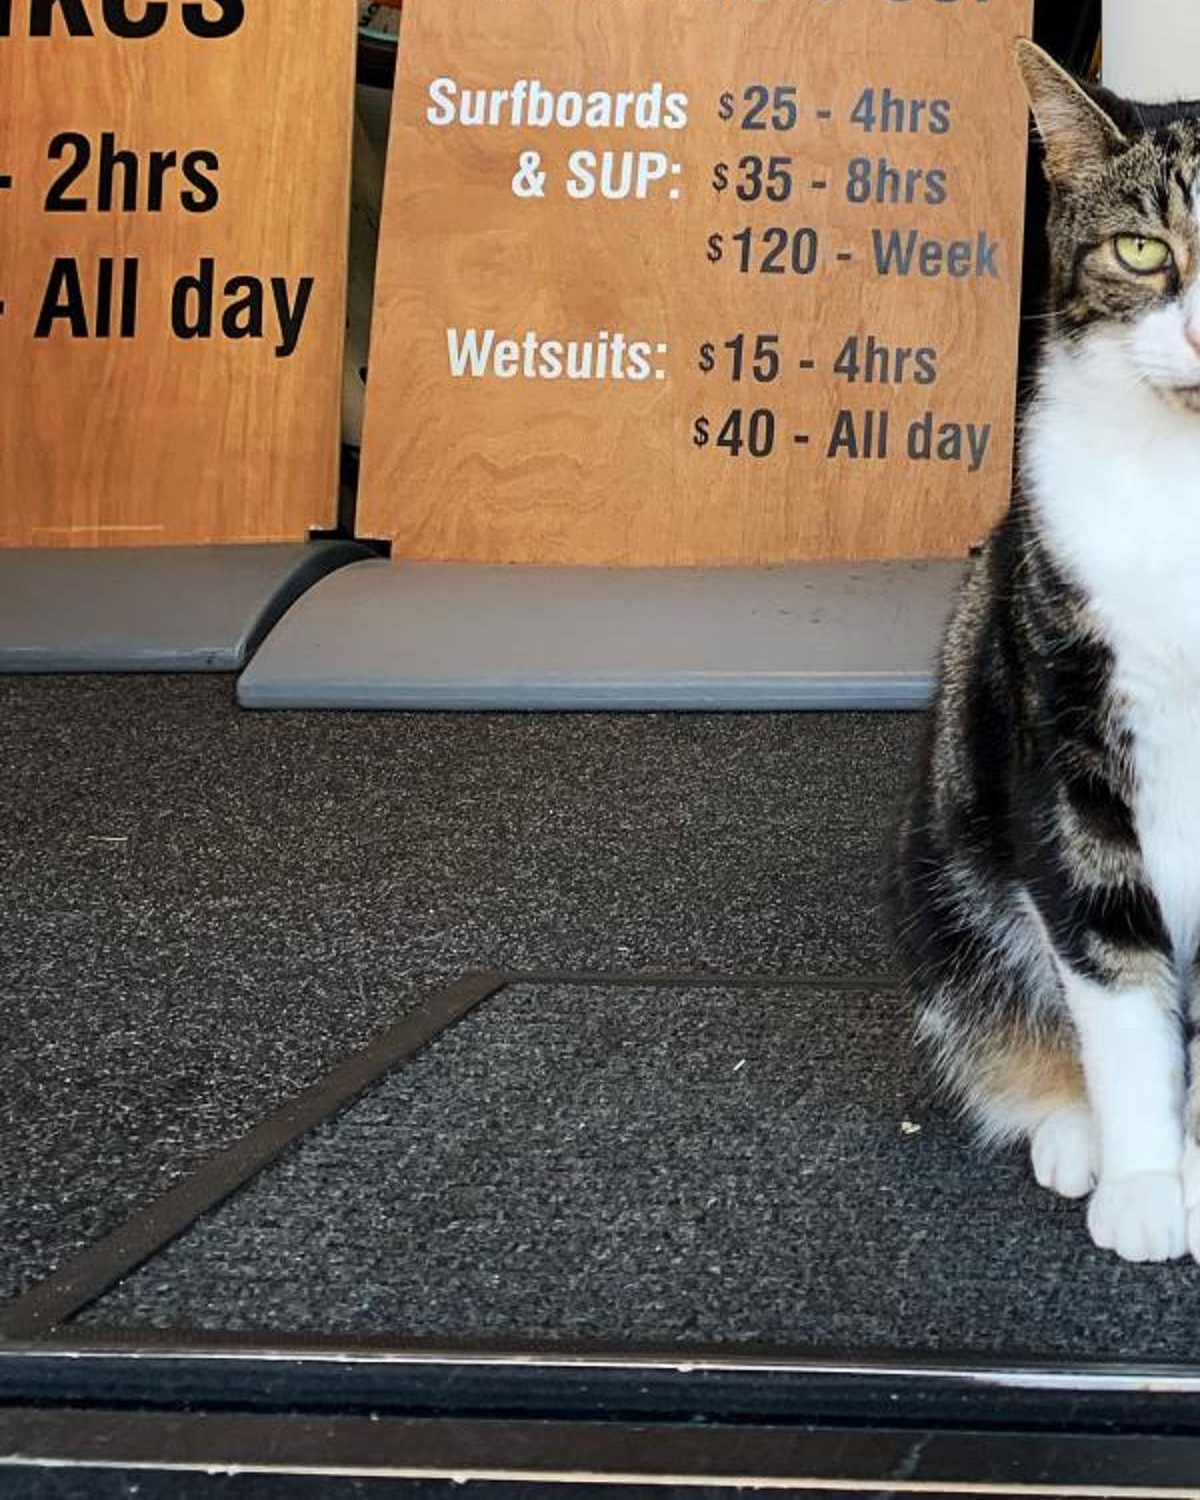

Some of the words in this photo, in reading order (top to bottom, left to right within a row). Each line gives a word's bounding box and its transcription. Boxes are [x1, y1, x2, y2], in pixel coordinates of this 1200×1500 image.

[426, 76, 689, 129] Surfboards
[717, 84, 798, 133] $25
[849, 86, 952, 135] 4hrs
[44, 132, 220, 213] 2hrs
[510, 150, 545, 198] &
[566, 150, 682, 200] SUP:
[712, 155, 793, 201] $35
[845, 156, 948, 206] 8hrs
[706, 226, 818, 275] $120
[871, 227, 1000, 278] Week
[33, 257, 140, 339] All
[170, 257, 315, 358] day
[446, 327, 667, 380] Wetsuits:
[698, 333, 780, 383] $15
[832, 335, 938, 385] 4hrs
[692, 408, 775, 458] $40
[826, 409, 889, 460] All
[906, 411, 991, 472] day
